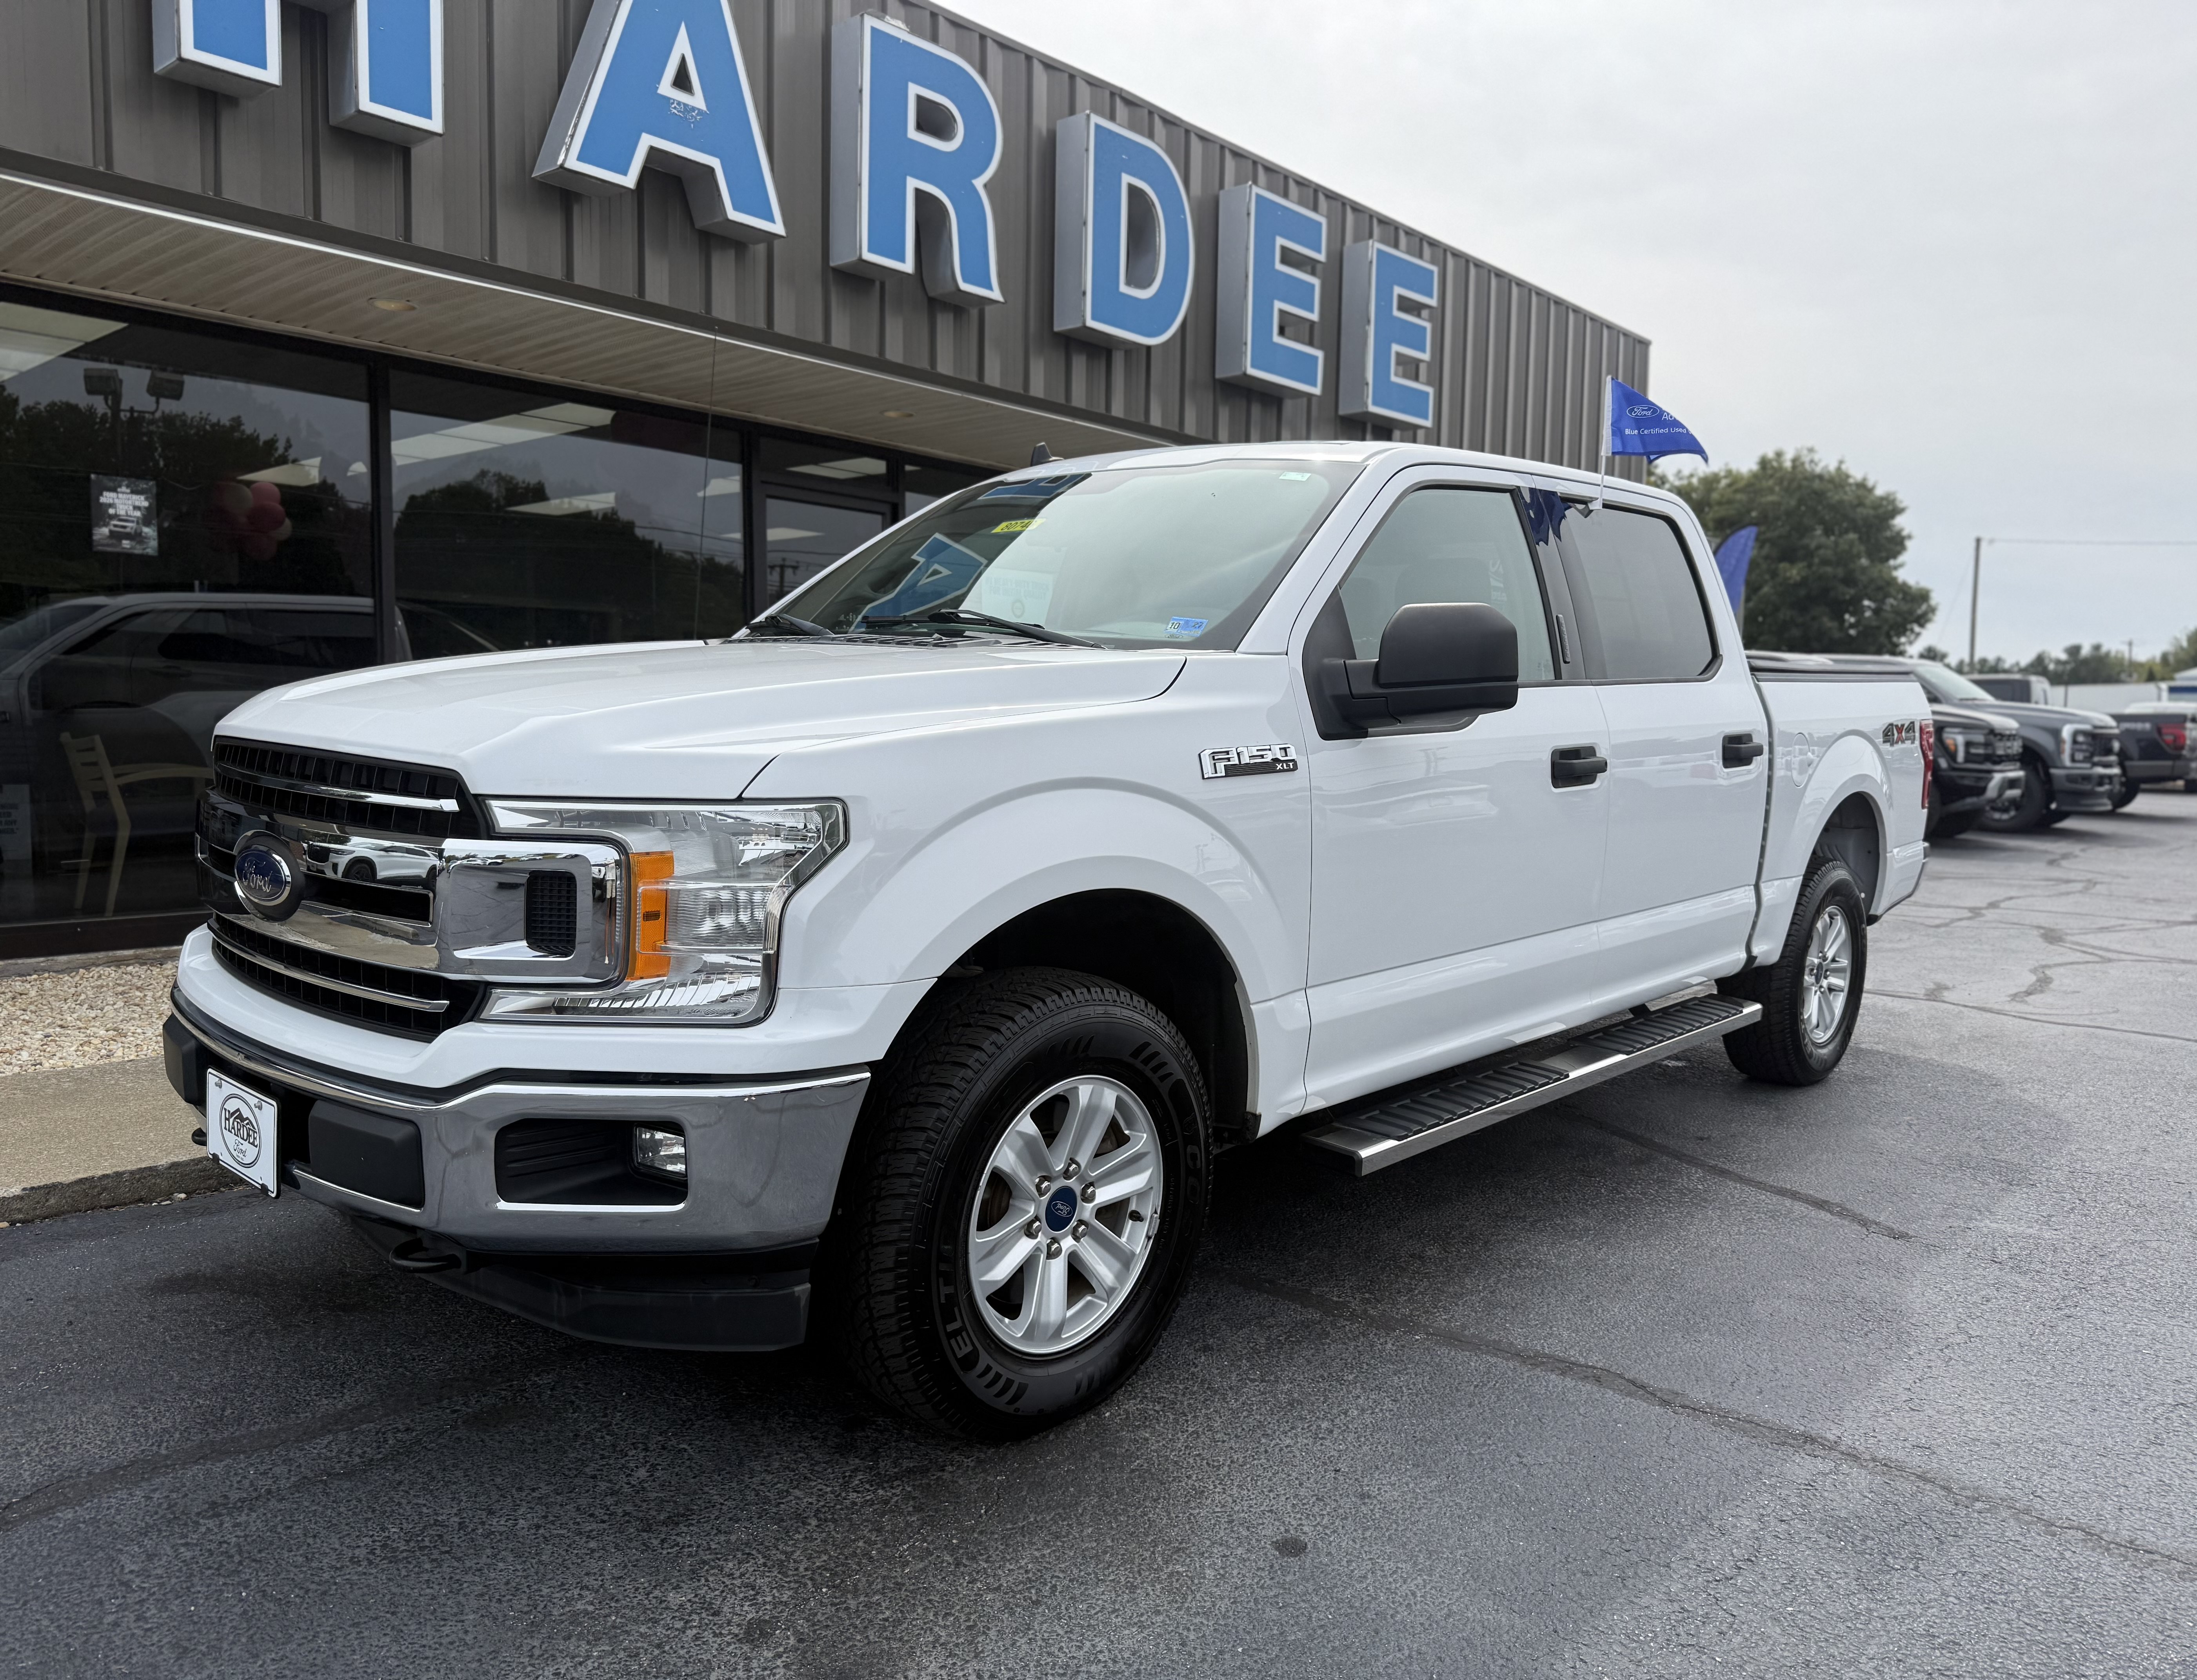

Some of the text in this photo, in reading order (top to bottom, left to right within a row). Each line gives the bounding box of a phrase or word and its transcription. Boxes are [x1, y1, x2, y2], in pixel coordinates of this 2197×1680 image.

[1632, 406, 1653, 416] Ford
[1276, 762, 1294, 770] XLT
[242, 857, 273, 892] Ford
[224, 1107, 258, 1148] HARDEE
[233, 1139, 247, 1157] Ford
[1055, 1203, 1070, 1215] Ford
